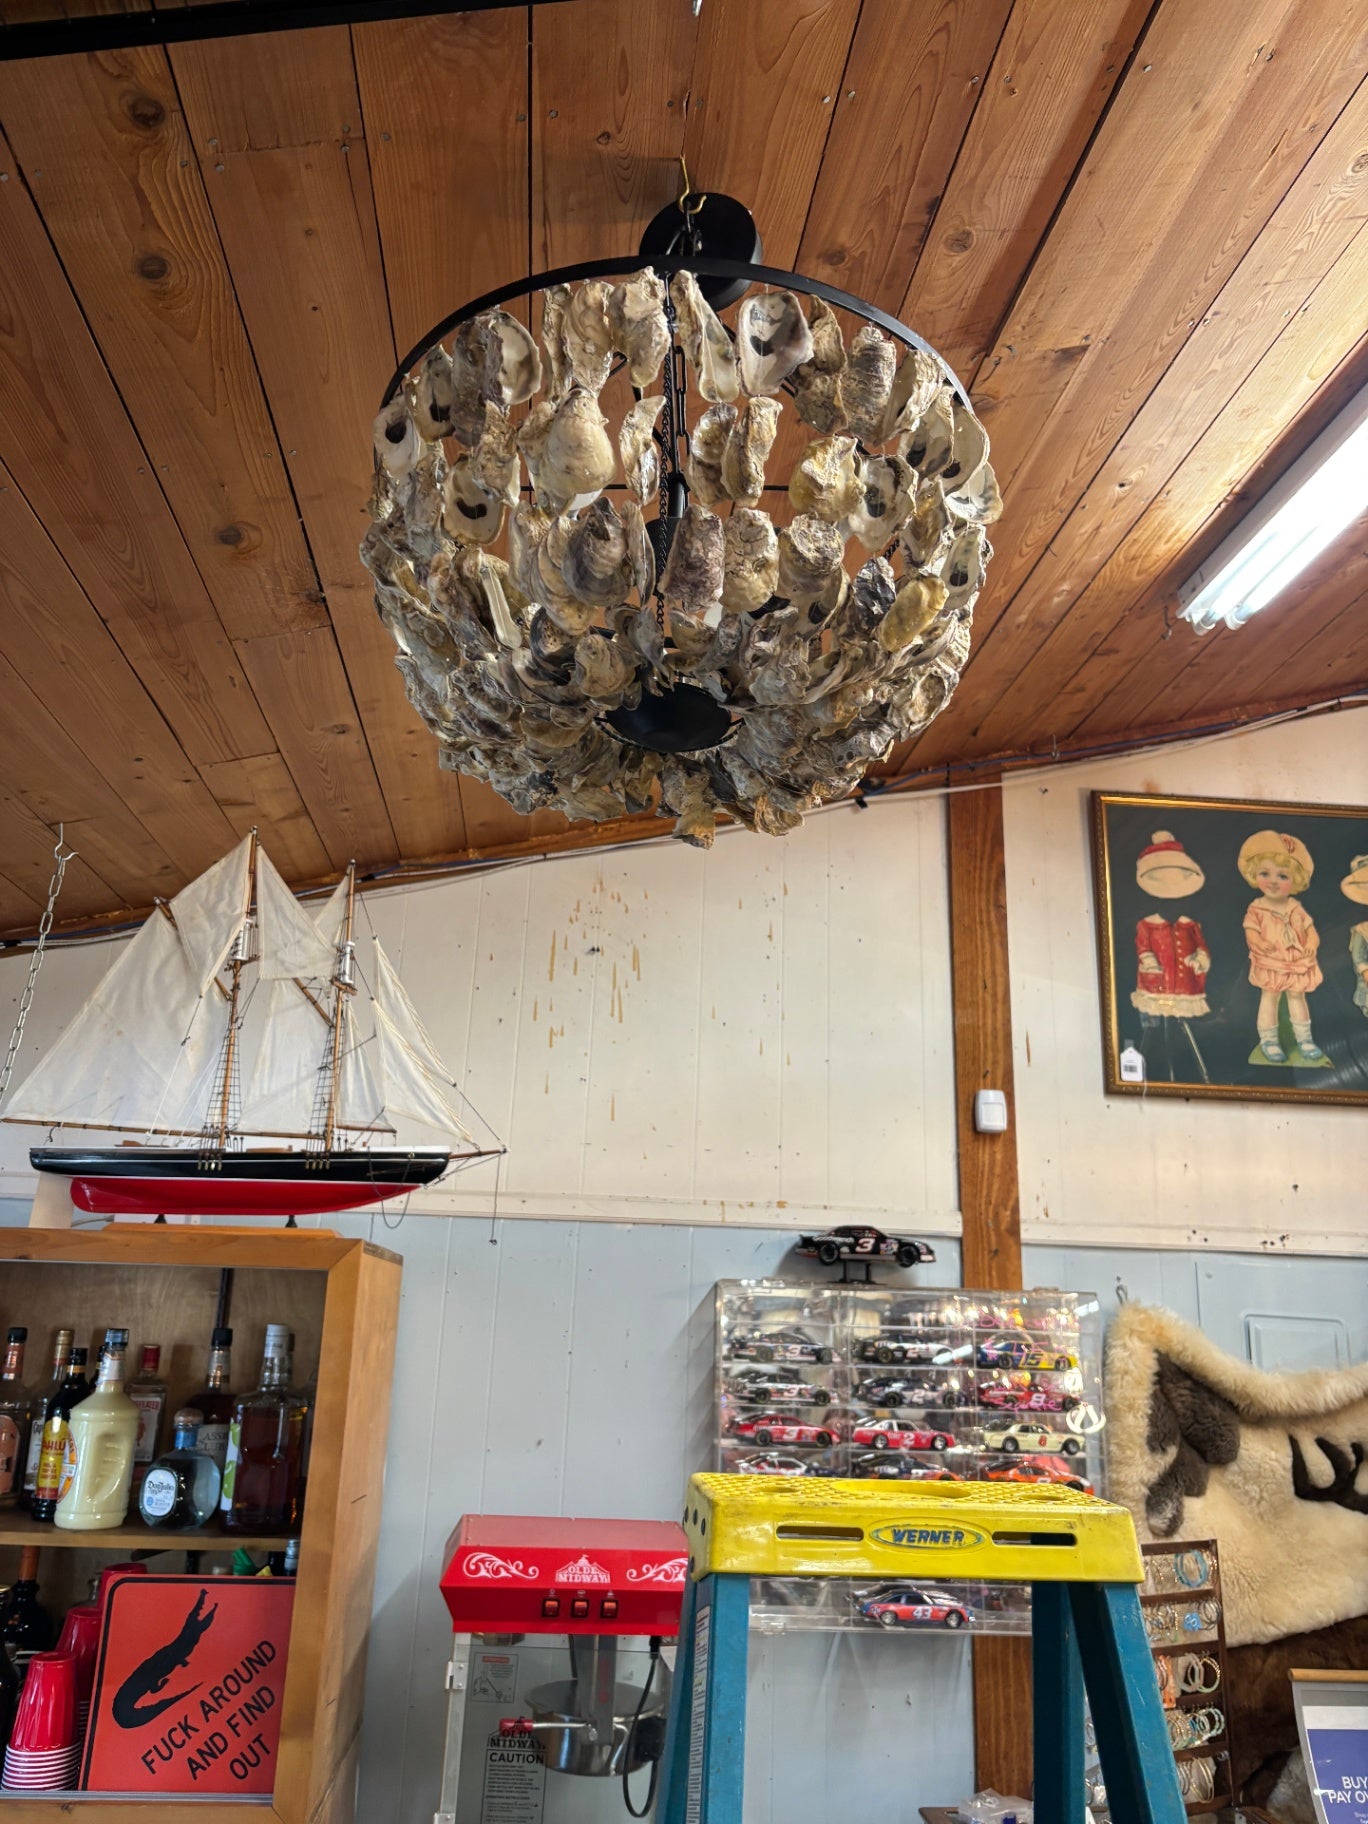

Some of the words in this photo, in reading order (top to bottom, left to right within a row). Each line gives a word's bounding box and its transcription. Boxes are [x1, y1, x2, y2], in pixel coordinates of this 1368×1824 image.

[855, 1238, 875, 1253] 3
[786, 1344, 800, 1357] 3
[911, 1389, 925, 1404] 2
[1029, 1393, 1046, 1408] 8
[783, 1427, 798, 1440] 3
[903, 1432, 915, 1446] 2
[892, 1528, 965, 1545] WERNER
[568, 1565, 599, 1575] OLDE
[558, 1574, 608, 1584] MIDWAY
[912, 1606, 932, 1620] 43
[140, 1714, 200, 1775] FUCK
[199, 1640, 276, 1723] AROUND
[186, 1731, 229, 1781] AND
[226, 1685, 275, 1738] FIND
[229, 1733, 271, 1780] OUT
[489, 1752, 544, 1764] CAUTION
[1341, 1776, 1368, 1789] BUY
[1328, 1790, 1352, 1804] PAY
